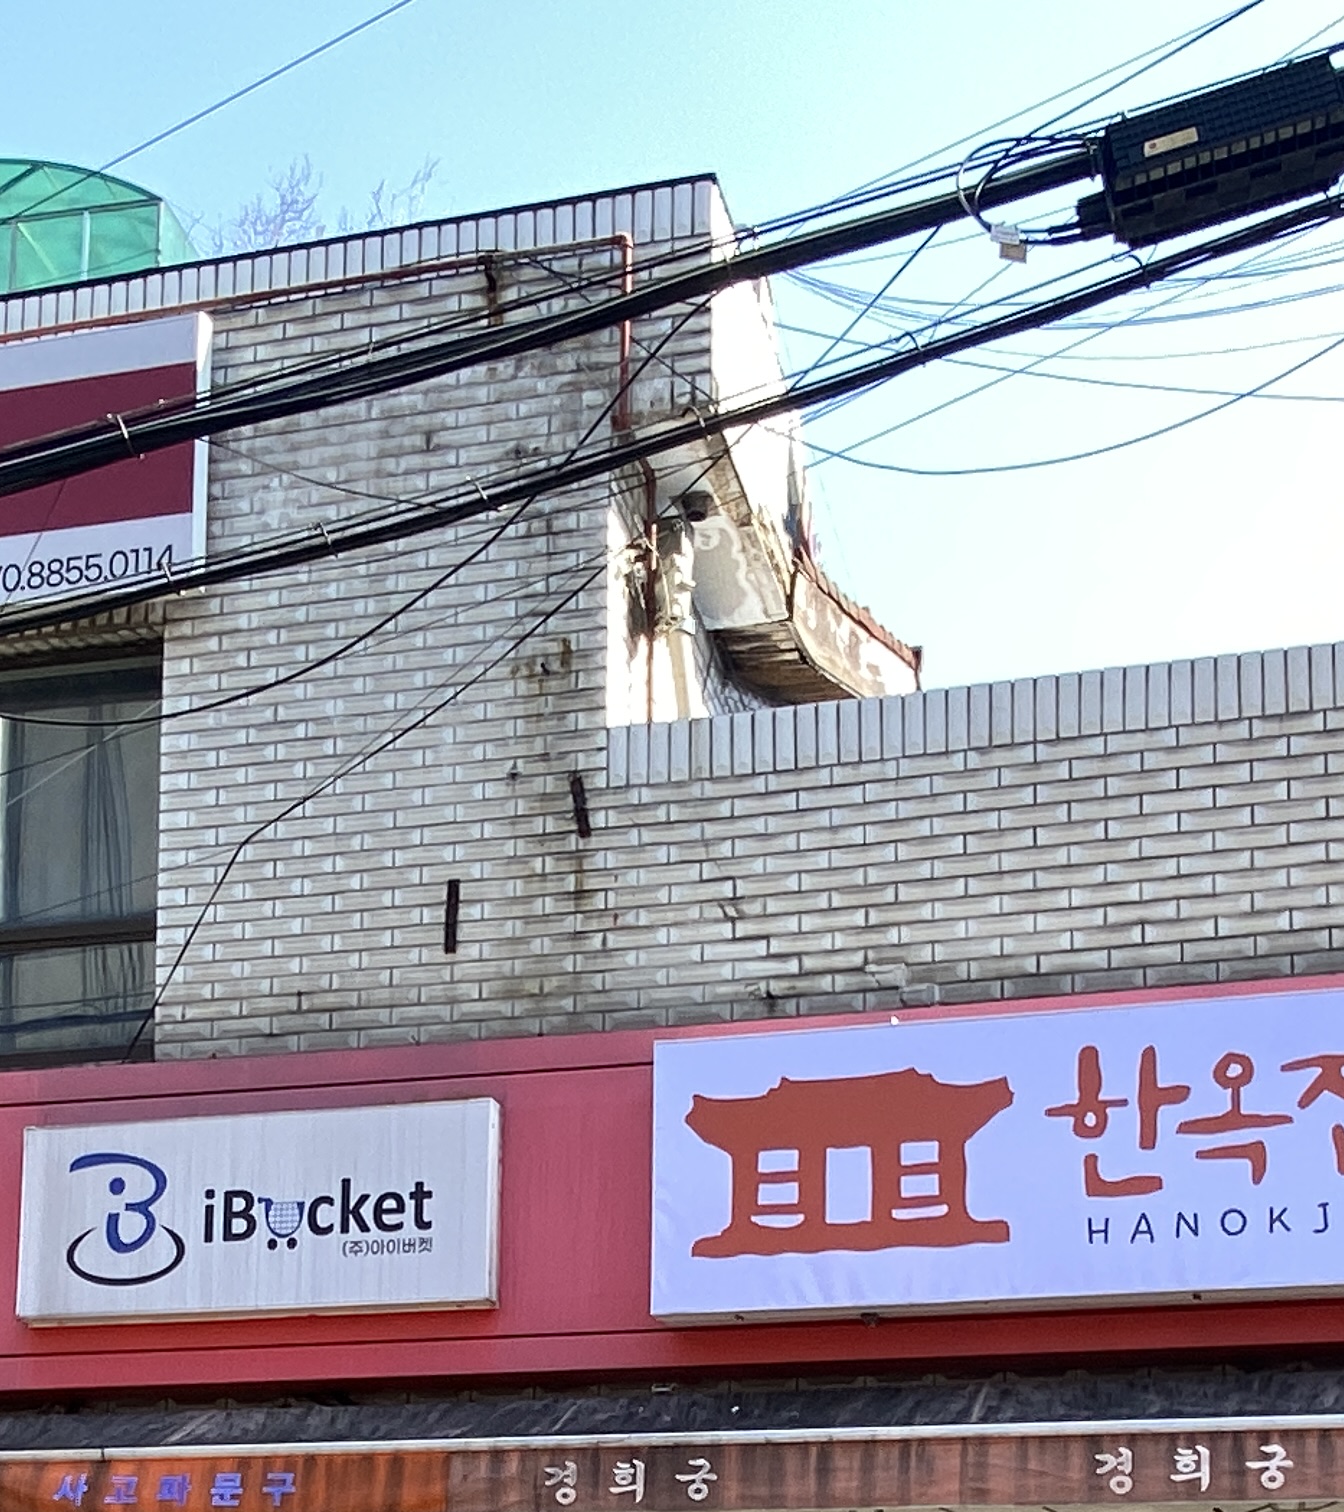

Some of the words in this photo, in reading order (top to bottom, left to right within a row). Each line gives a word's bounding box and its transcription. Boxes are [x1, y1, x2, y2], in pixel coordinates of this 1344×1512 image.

[341, 1236, 433, 1258] (주)아이버켓
[543, 1452, 718, 1506] 경희궁
[1094, 1442, 1297, 1495] 경희궁
